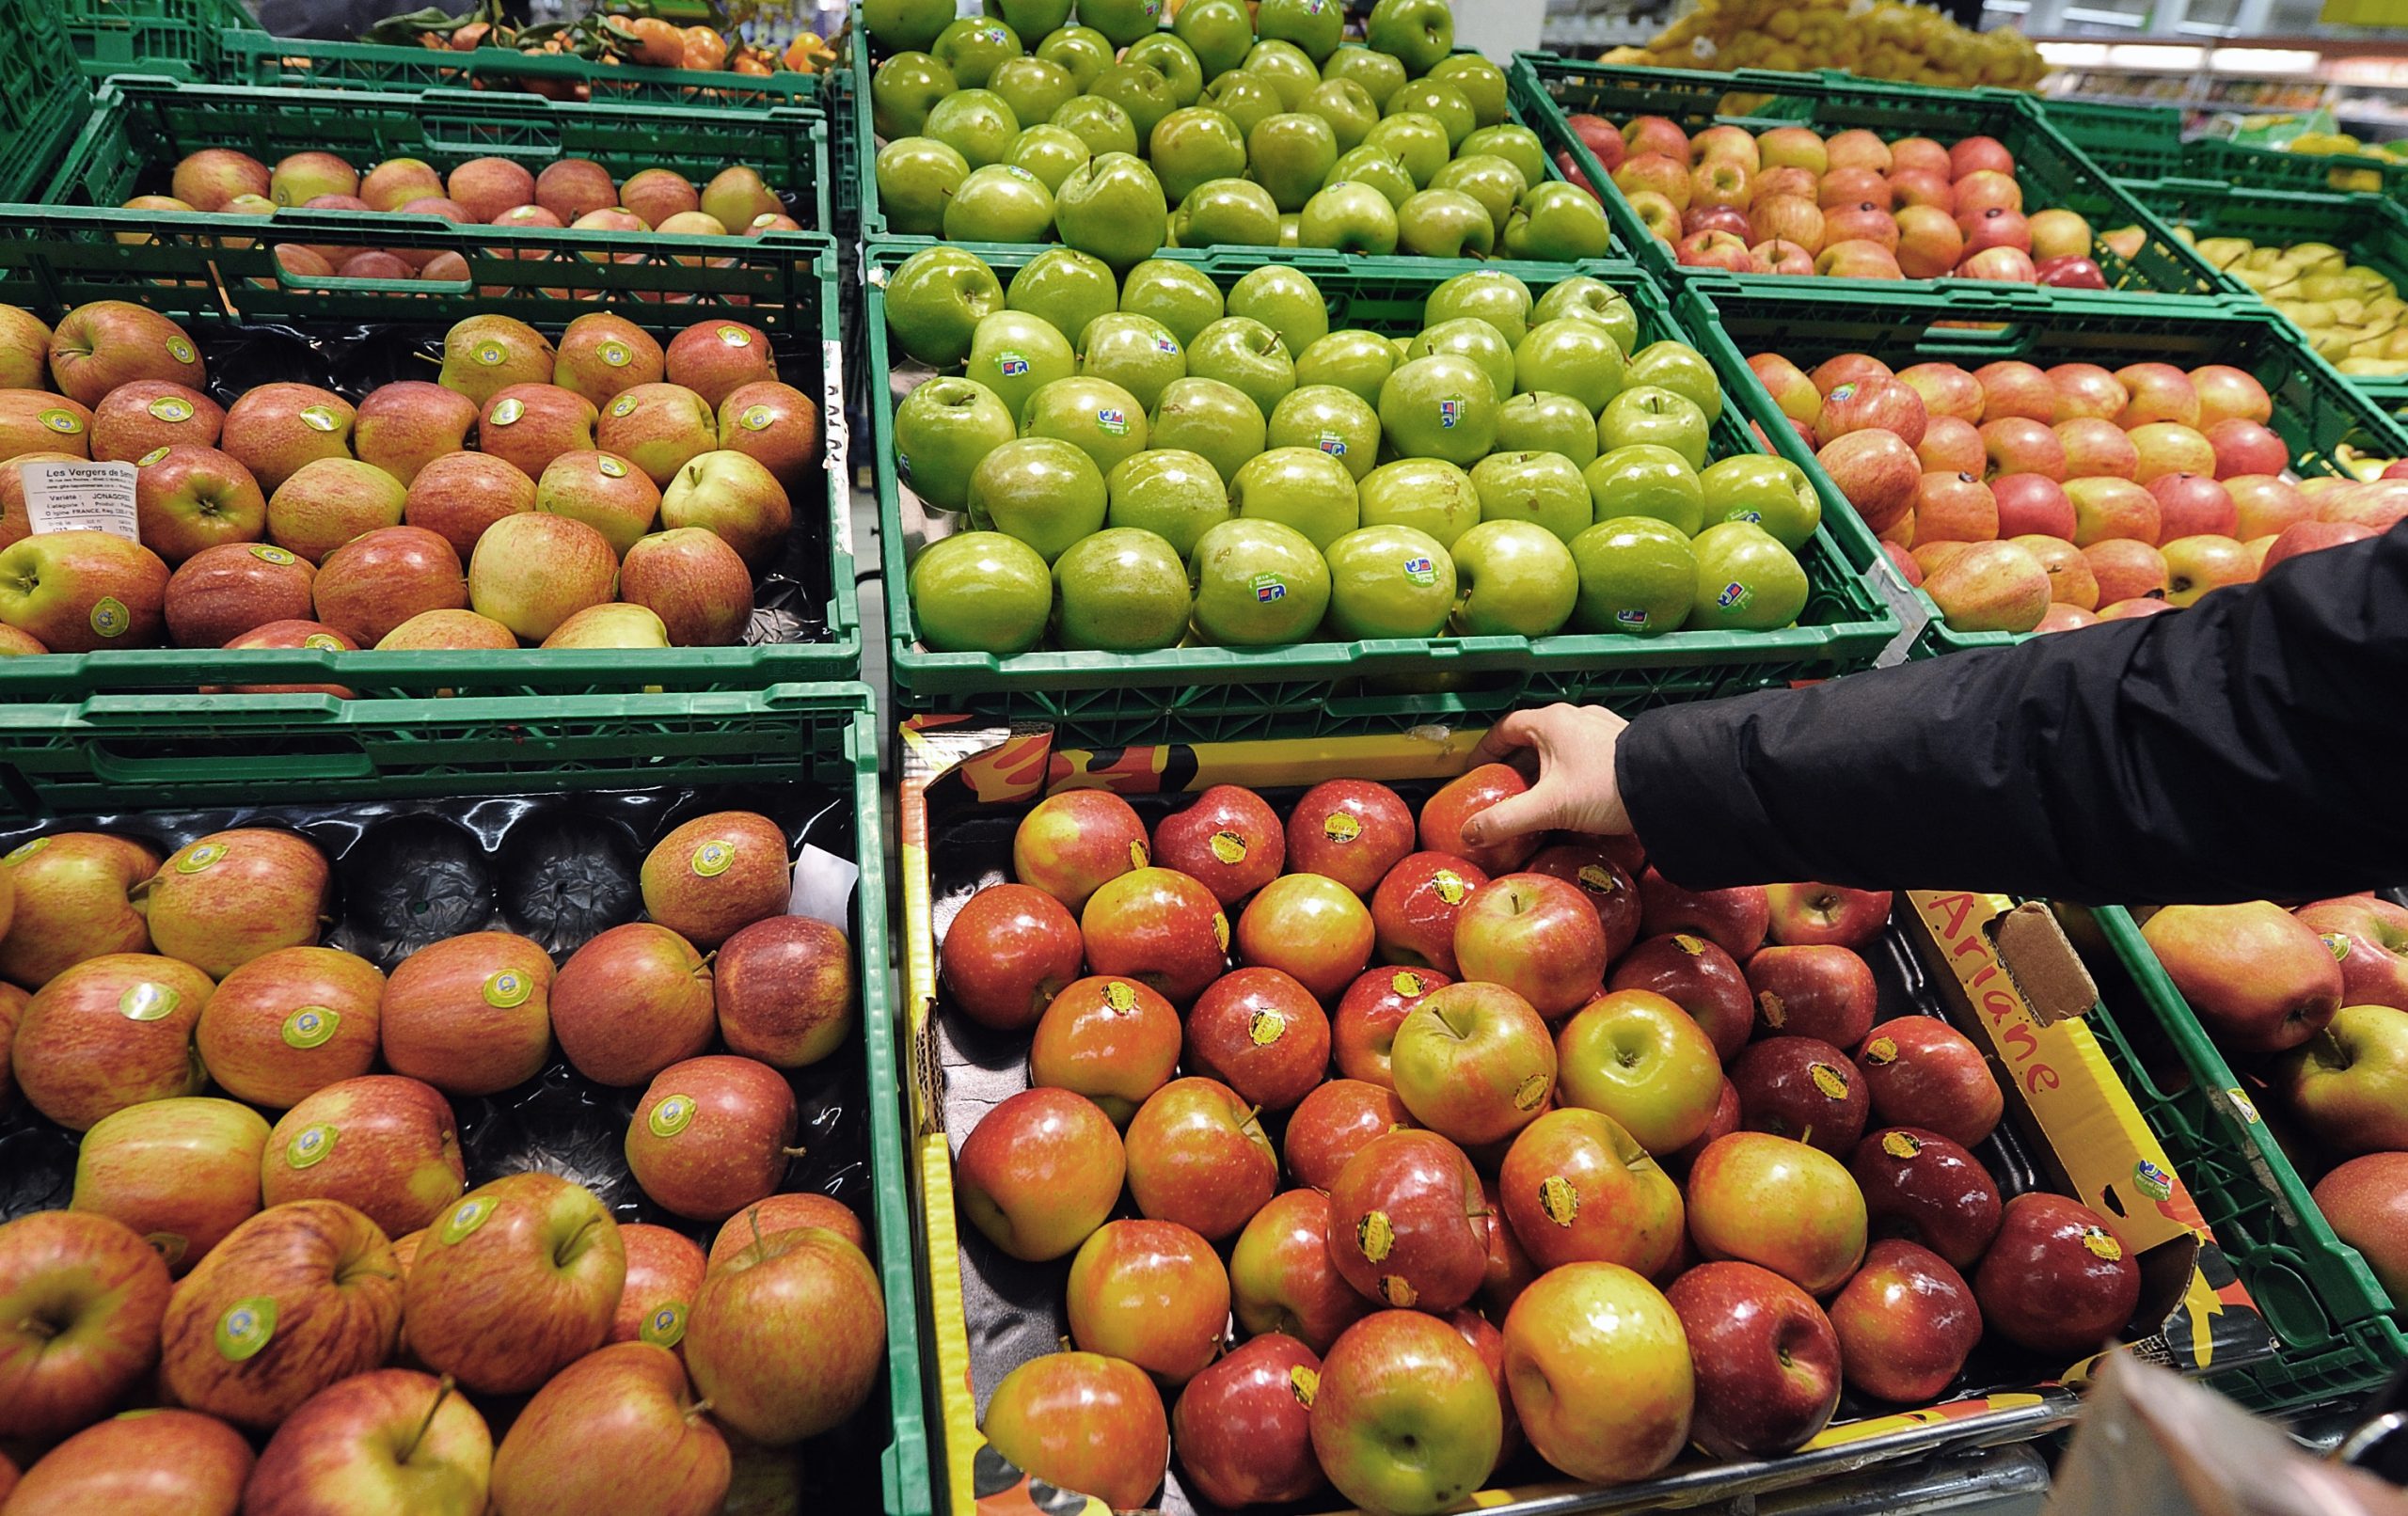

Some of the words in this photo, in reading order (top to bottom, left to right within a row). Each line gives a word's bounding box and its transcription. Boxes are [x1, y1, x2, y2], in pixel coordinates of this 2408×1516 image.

[69, 468, 106, 478] Vergers
[1328, 820, 1355, 832] Ariane
[1581, 870, 1610, 888] Ariane
[1928, 893, 2060, 1094] Ariane
[1816, 1068, 1845, 1094] Ariane
[1549, 1179, 1565, 1219] Ariane
[1369, 1219, 1383, 1255] Ariane
